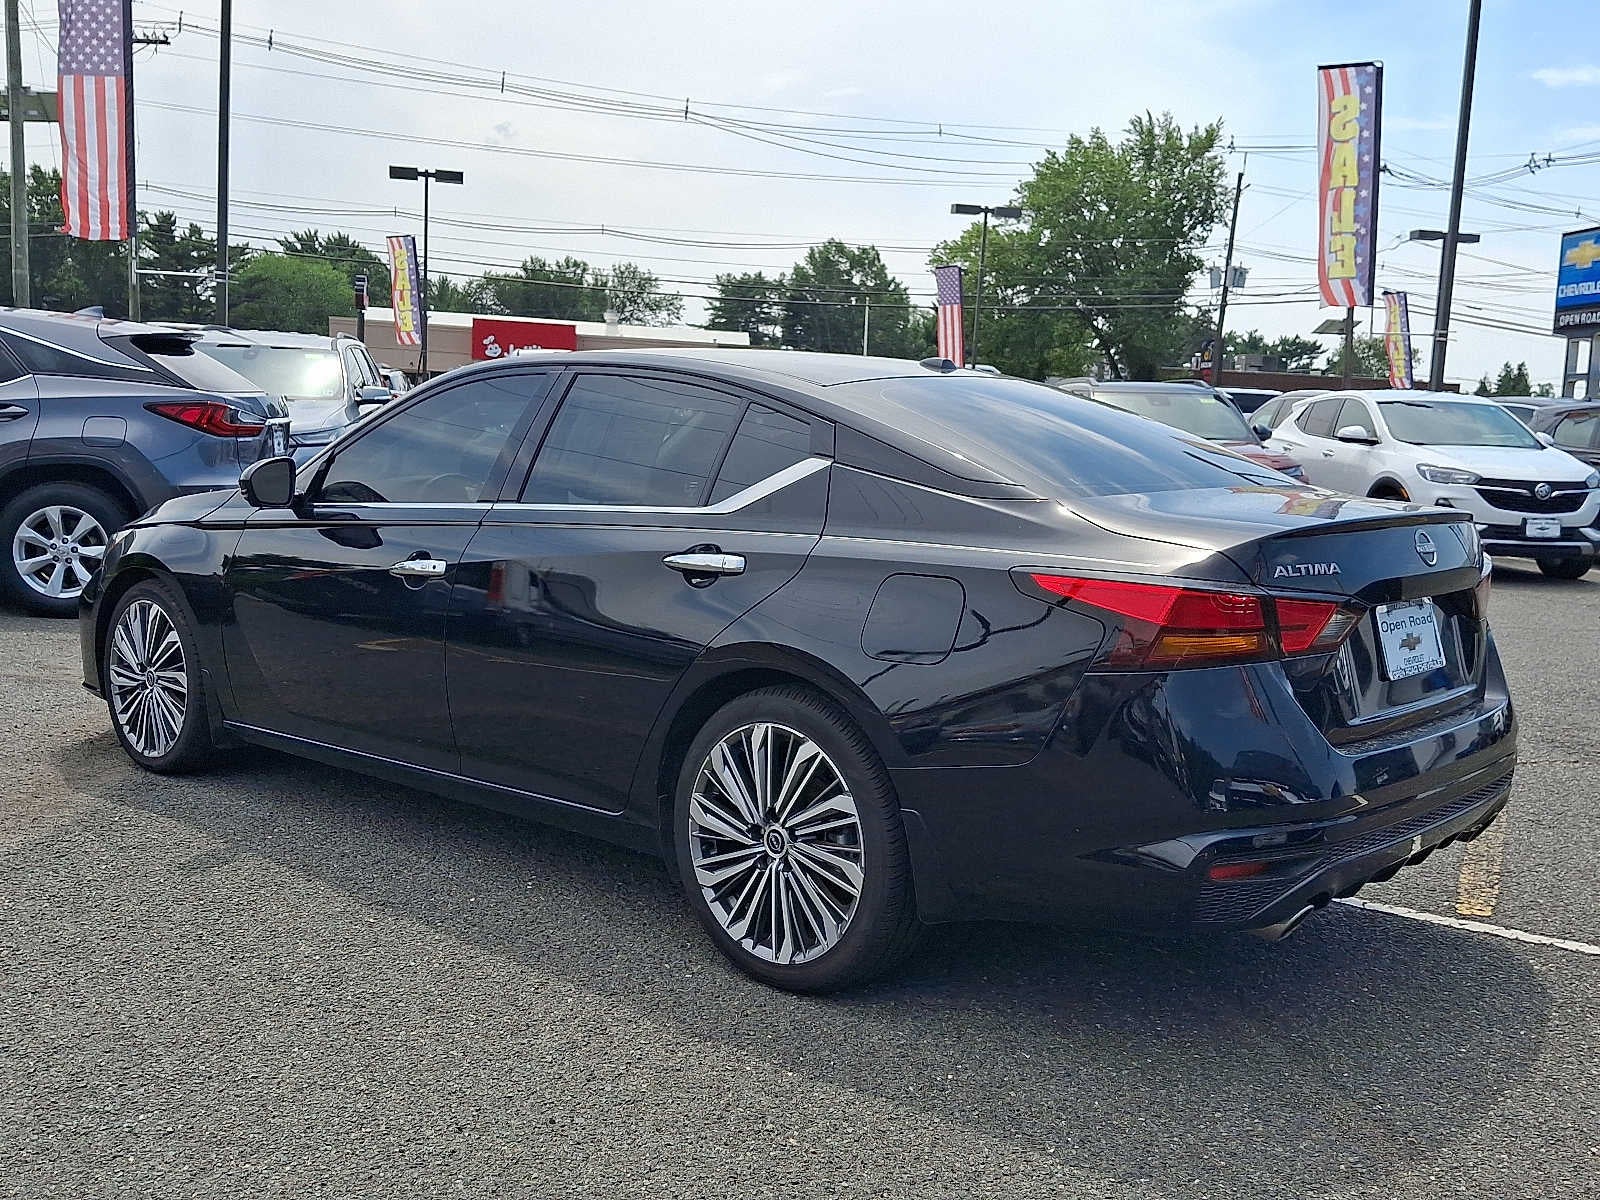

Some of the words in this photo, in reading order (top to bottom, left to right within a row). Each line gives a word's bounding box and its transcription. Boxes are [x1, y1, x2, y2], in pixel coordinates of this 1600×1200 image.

[1559, 313, 1580, 326] OPEN
[1274, 562, 1341, 579] ALTIMA
[1381, 620, 1407, 634] Open
[1409, 612, 1433, 627] Road
